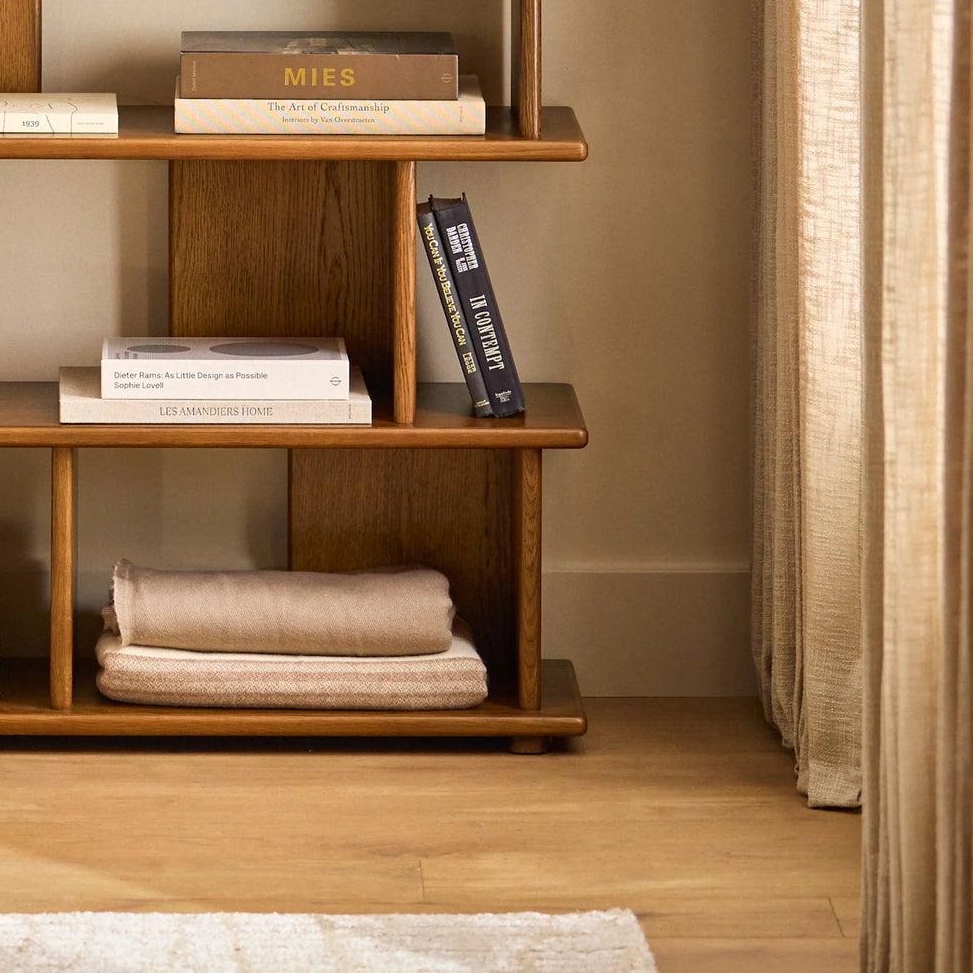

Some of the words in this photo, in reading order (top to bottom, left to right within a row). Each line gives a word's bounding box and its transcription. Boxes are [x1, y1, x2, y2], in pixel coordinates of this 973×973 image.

[284, 67, 356, 86] MIES
[267, 102, 286, 112] The
[289, 102, 305, 112] Art
[307, 102, 318, 112] of
[320, 102, 390, 114] Craftsmanship
[310, 117, 319, 125] by
[424, 223, 434, 240] YOU
[446, 226, 463, 254] DARDEN
[429, 240, 440, 258] CAN
[457, 223, 479, 270] CHRISTOPHER
[434, 257, 443, 265] IF
[437, 264, 447, 282] YOU
[441, 281, 456, 313] BELIEVE
[469, 294, 487, 309] IN
[451, 311, 461, 328] YOU
[456, 328, 466, 346] CAN
[475, 311, 504, 370] CONTEMPT
[197, 372, 223, 380] Design
[114, 382, 140, 390] Sophie
[160, 407, 177, 416] LES
[179, 407, 239, 416] AMANDIERS
[241, 407, 273, 416] HOME
